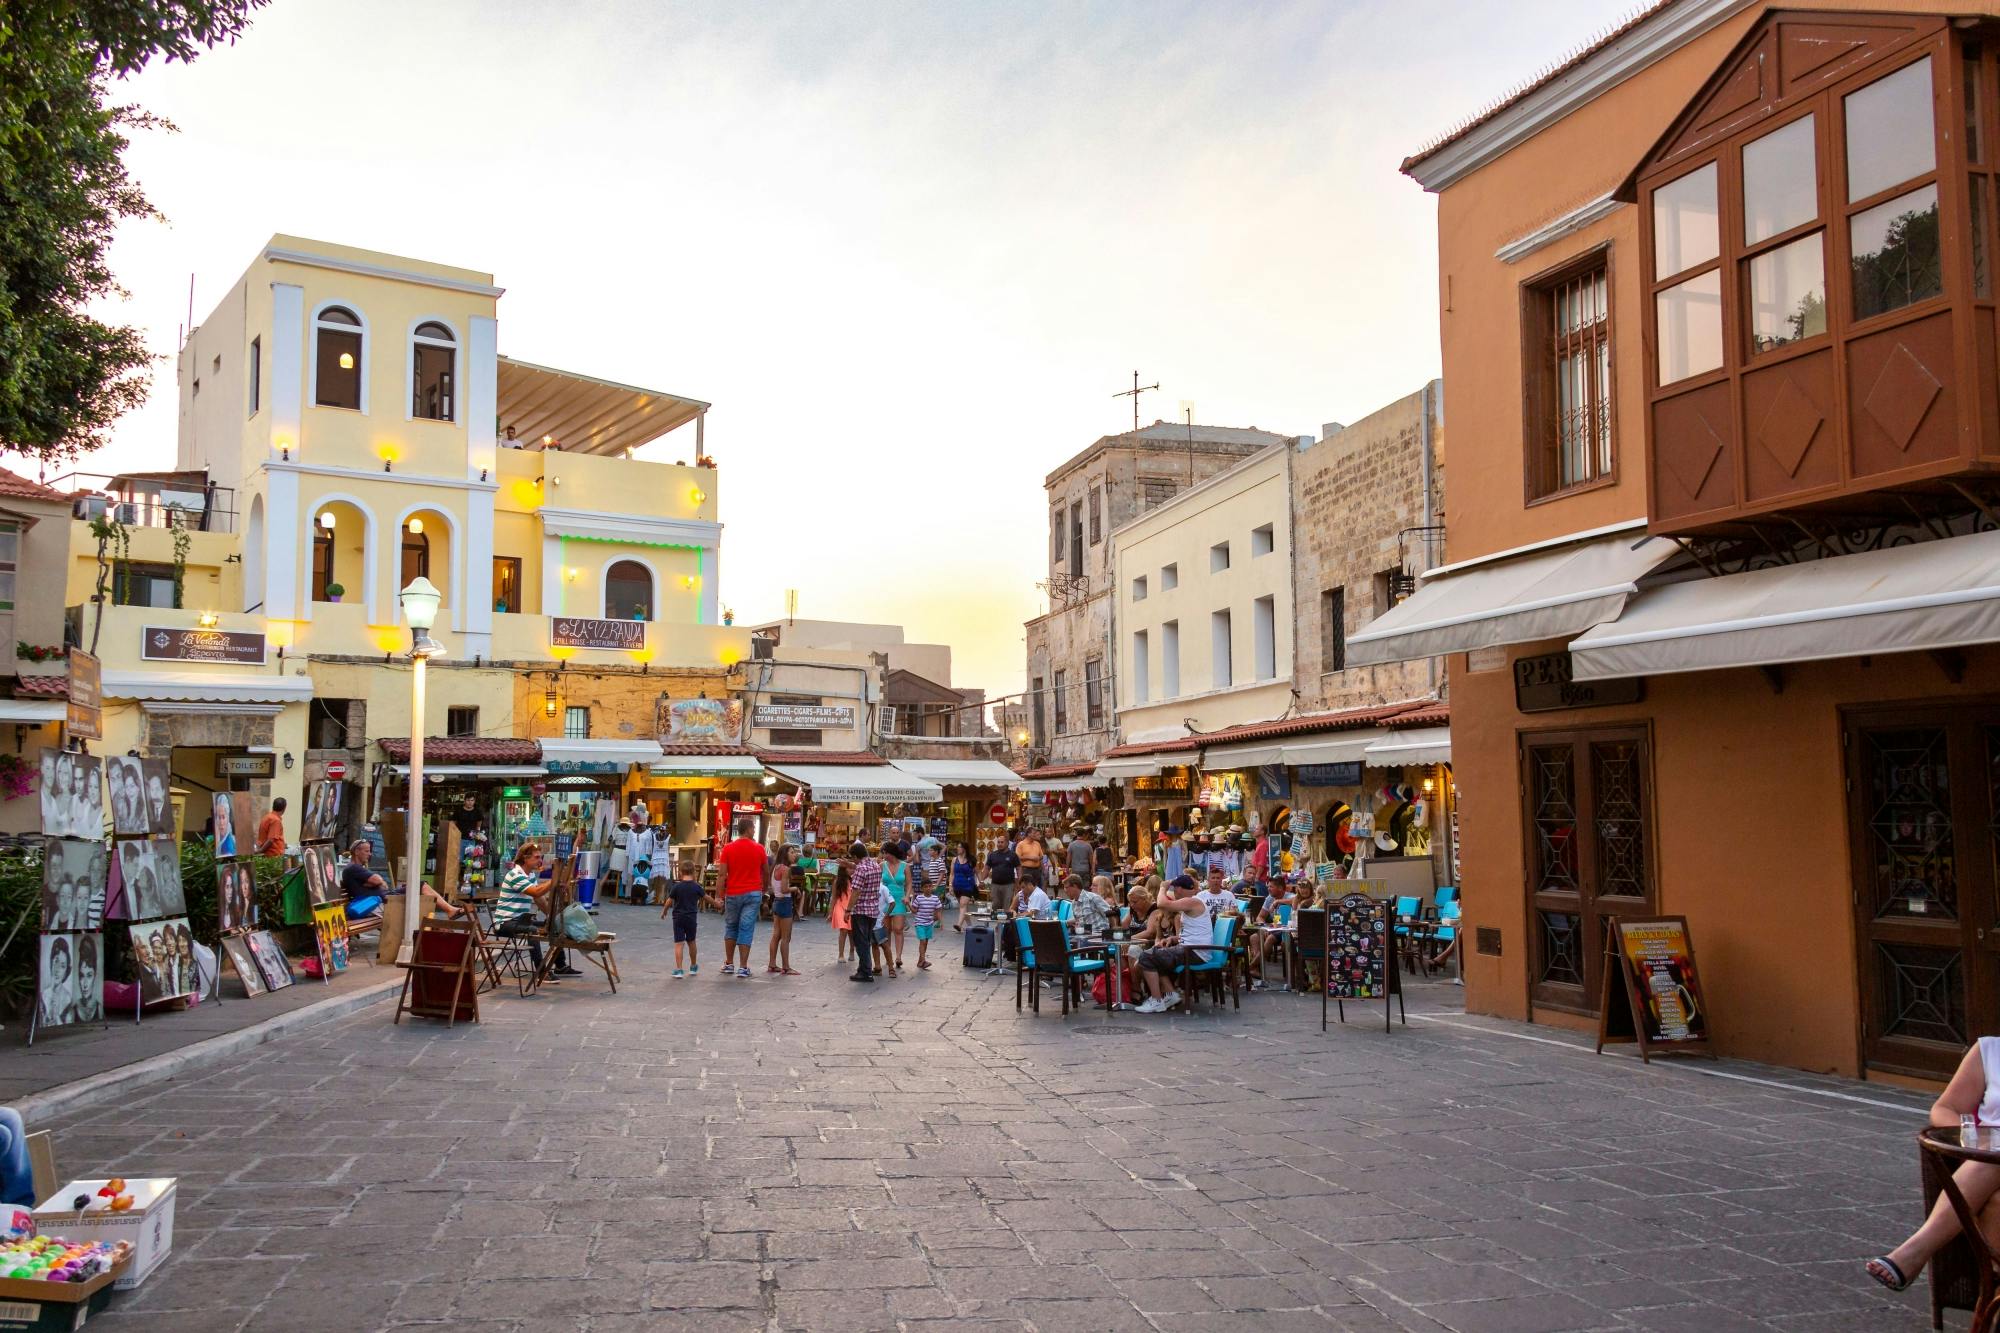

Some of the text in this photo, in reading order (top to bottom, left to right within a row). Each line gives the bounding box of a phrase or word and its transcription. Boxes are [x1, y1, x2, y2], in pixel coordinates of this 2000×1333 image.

[569, 619, 643, 642] LA VERANDA
[1518, 655, 1573, 688] PER
